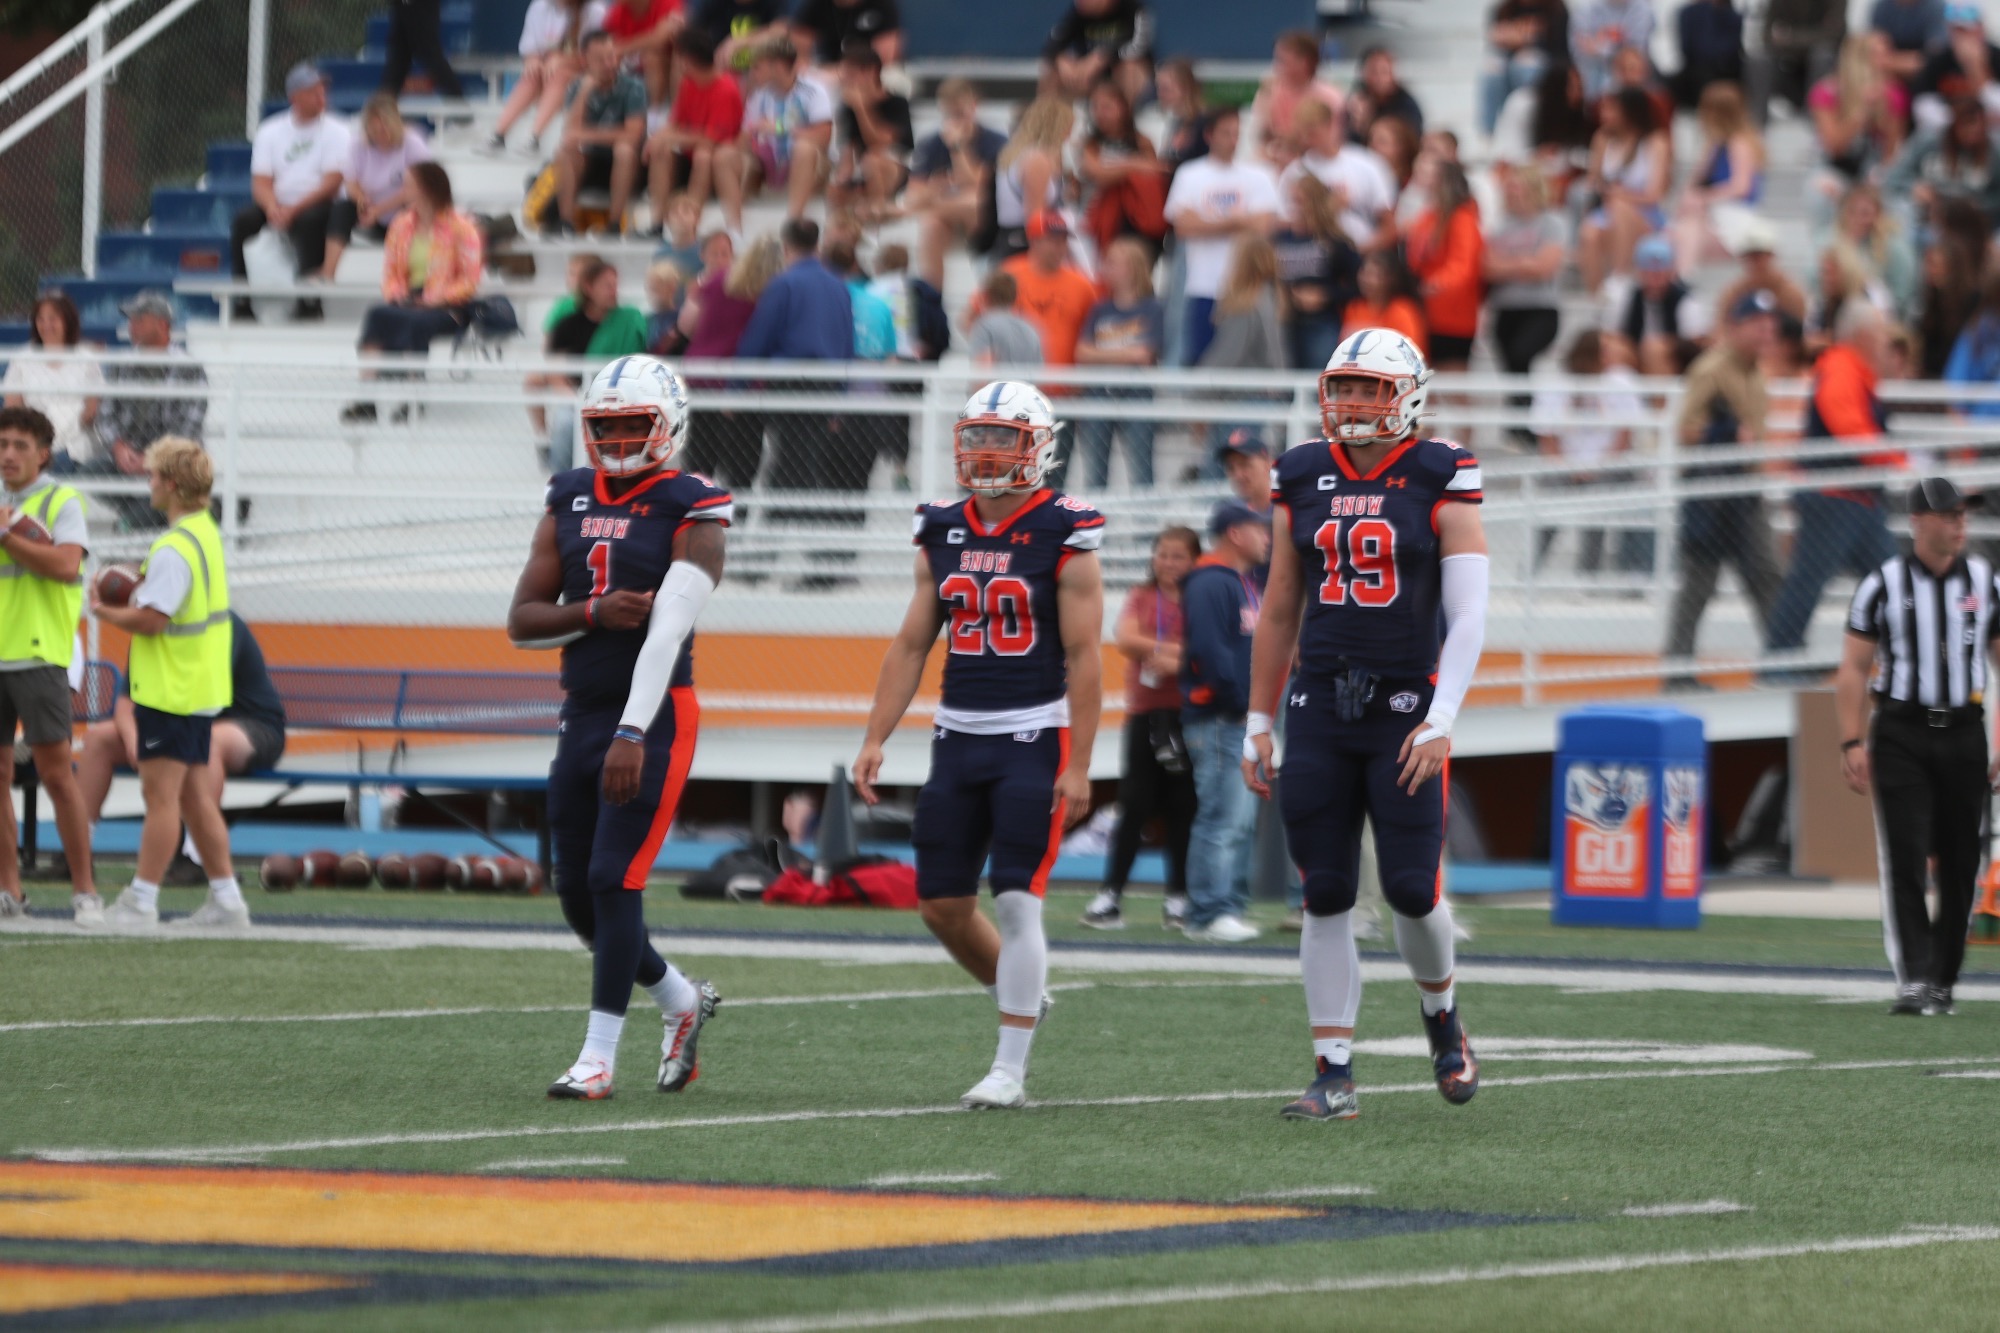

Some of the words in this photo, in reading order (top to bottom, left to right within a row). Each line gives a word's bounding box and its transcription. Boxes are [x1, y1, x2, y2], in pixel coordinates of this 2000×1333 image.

[1317, 475, 1336, 491] C
[571, 496, 589, 512] C
[1330, 495, 1384, 517] SNOW
[580, 516, 630, 540] SNOW
[946, 528, 965, 545] C
[586, 541, 611, 596] 1
[960, 550, 1011, 574] SNOW
[1314, 519, 1400, 608] 19
[939, 574, 1036, 657] 20
[1576, 832, 1635, 874] GO
